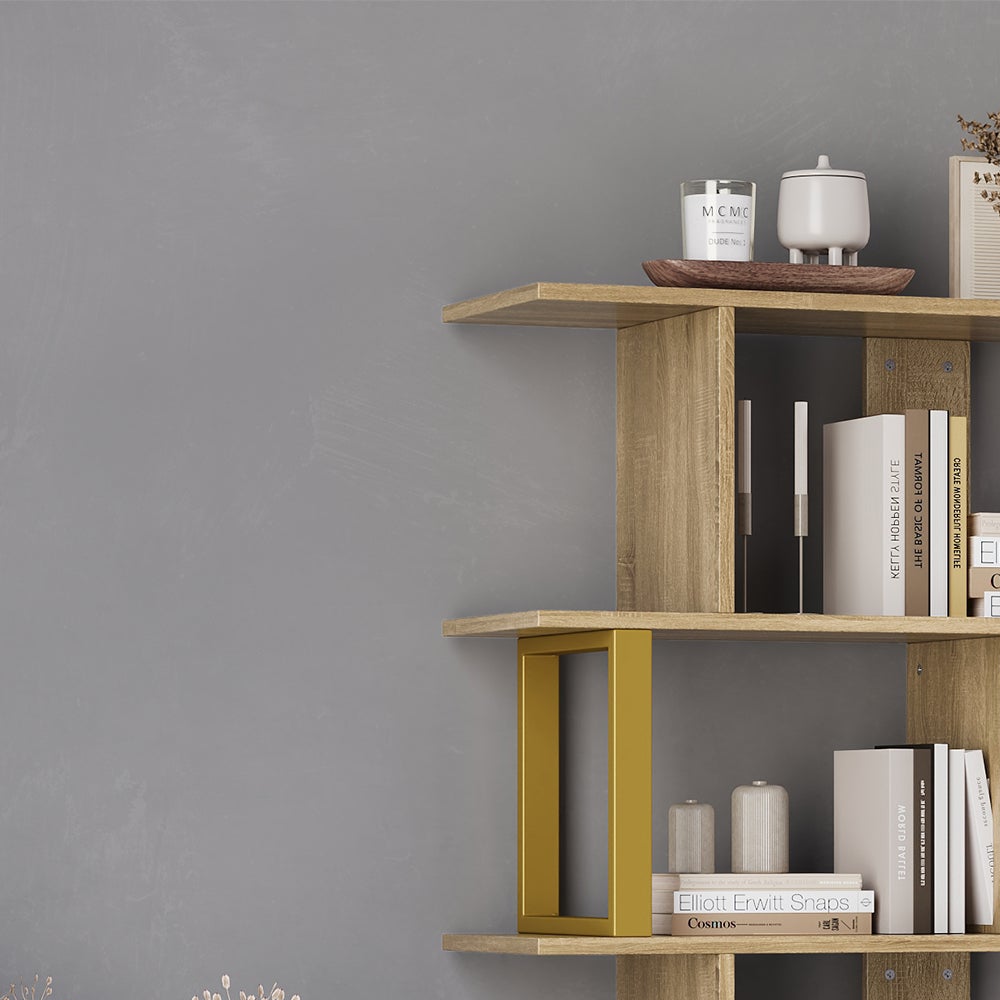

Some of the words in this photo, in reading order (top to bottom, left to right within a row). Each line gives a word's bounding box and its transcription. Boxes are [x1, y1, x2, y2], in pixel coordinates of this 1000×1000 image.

[702, 206, 748, 218] MCMC
[680, 894, 726, 911] Elliott
[734, 894, 784, 912] Erwitt
[791, 894, 849, 914] Snaps
[688, 918, 736, 929] Cosmos
